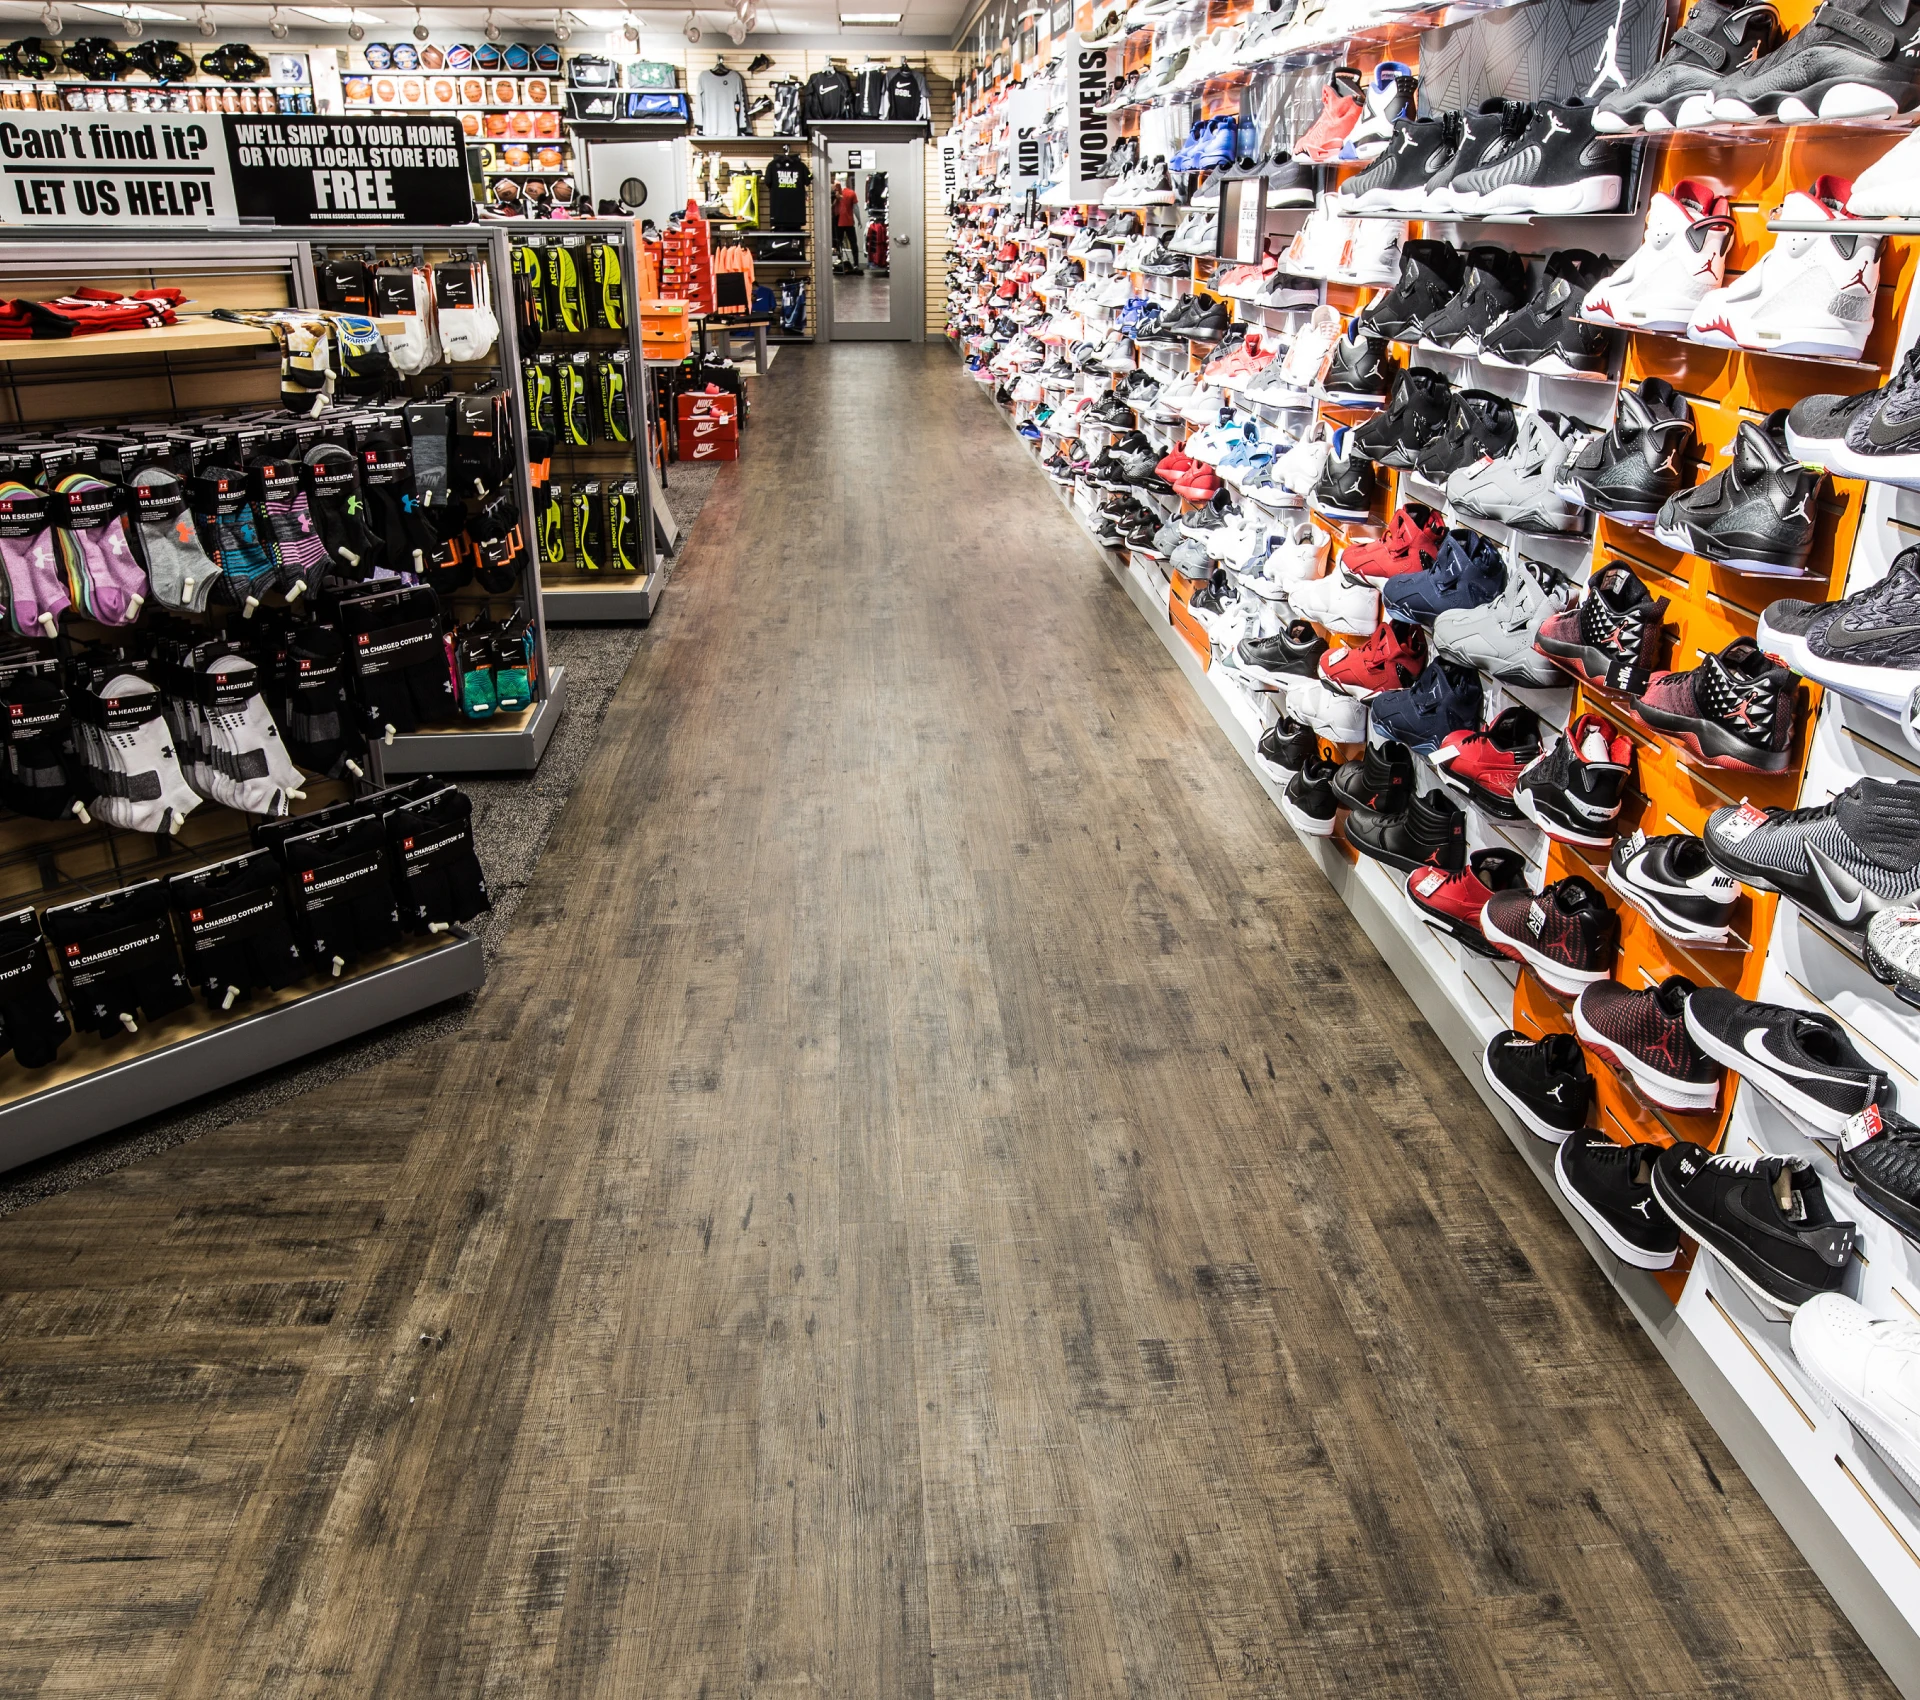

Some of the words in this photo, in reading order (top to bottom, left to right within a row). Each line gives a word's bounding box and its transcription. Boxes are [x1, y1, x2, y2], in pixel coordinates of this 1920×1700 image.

[1834, 14, 1850, 29] AIR
[1853, 22, 1887, 48] JORDAN
[1695, 38, 1722, 62] JORDAN
[1078, 51, 1108, 182] WOMENS
[0, 122, 86, 158] Can't
[89, 124, 158, 160] find
[161, 124, 208, 160] it?
[235, 124, 285, 145] WE'LL
[287, 124, 328, 145] SHIP
[331, 125, 354, 145] TO
[356, 125, 404, 146] YOUR
[406, 126, 456, 146] HOME
[238, 147, 264, 167] OR
[264, 147, 313, 167] YOUR
[316, 147, 368, 167] LOCAL
[370, 148, 425, 168] STORE
[426, 148, 460, 168] FOR
[1018, 127, 1039, 177] KIDS
[14, 179, 66, 215] LET
[73, 179, 121, 216] US
[124, 180, 215, 216] HELP!
[312, 170, 397, 209] FREE
[549, 261, 557, 286] ARCH
[594, 258, 602, 283] ARCH
[344, 331, 380, 345] WARRIORS
[527, 379, 535, 411] ORTHOTIC
[696, 399, 713, 407] NIKE
[697, 422, 714, 430] NIKE
[697, 443, 714, 451] NIKE
[376, 461, 406, 470] ESSENTIAL
[275, 476, 299, 484] ESSENTIAL
[325, 473, 354, 482] ESSENTIAL
[82, 501, 113, 511] ESSENTIAL
[150, 495, 181, 505] ESSENTIAL
[370, 641, 400, 653] CHARGED
[400, 636, 423, 646] COTTON
[226, 681, 253, 691] HEATGEAR
[23, 713, 60, 723] HEATGEAR
[119, 705, 152, 715] HEATGEAR
[1736, 807, 1764, 828] SALE
[413, 843, 439, 856] CHARGED
[439, 836, 457, 847] COTTON
[304, 885, 314, 893] UA
[314, 876, 345, 890] CHARGED
[345, 868, 368, 880] COTTON
[1711, 877, 1734, 888] NIKE
[204, 914, 237, 929] CHARGED
[238, 905, 263, 918] COTTON
[264, 901, 273, 909] 2.0
[69, 959, 80, 967] UA
[81, 947, 118, 964] CHARGED
[119, 938, 149, 953] COTTON
[150, 934, 160, 942] 2.0
[0, 969, 19, 980] TTON
[21, 963, 32, 971] 2.0
[1863, 1108, 1878, 1138] SALE
